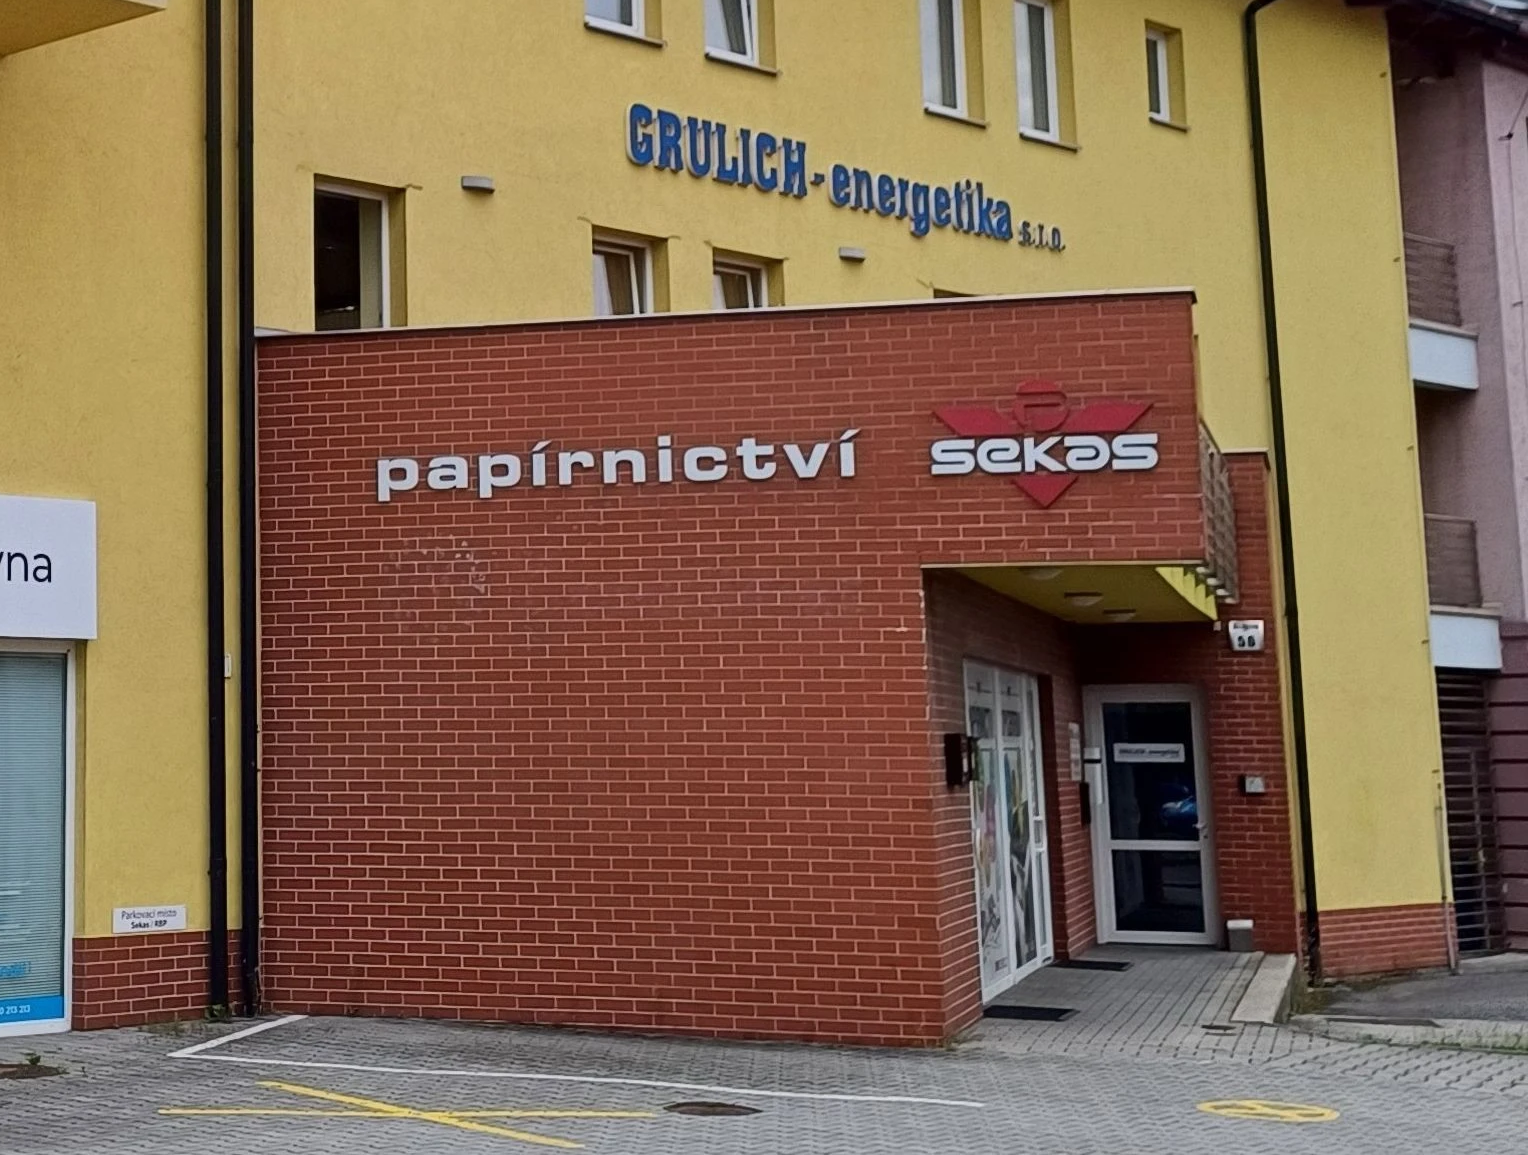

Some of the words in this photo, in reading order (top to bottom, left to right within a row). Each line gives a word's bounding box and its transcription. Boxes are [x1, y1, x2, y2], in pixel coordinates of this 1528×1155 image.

[377, 428, 861, 502] papírnictví
[5, 1006, 18, 1014] 213
[19, 1005, 30, 1013] 213
